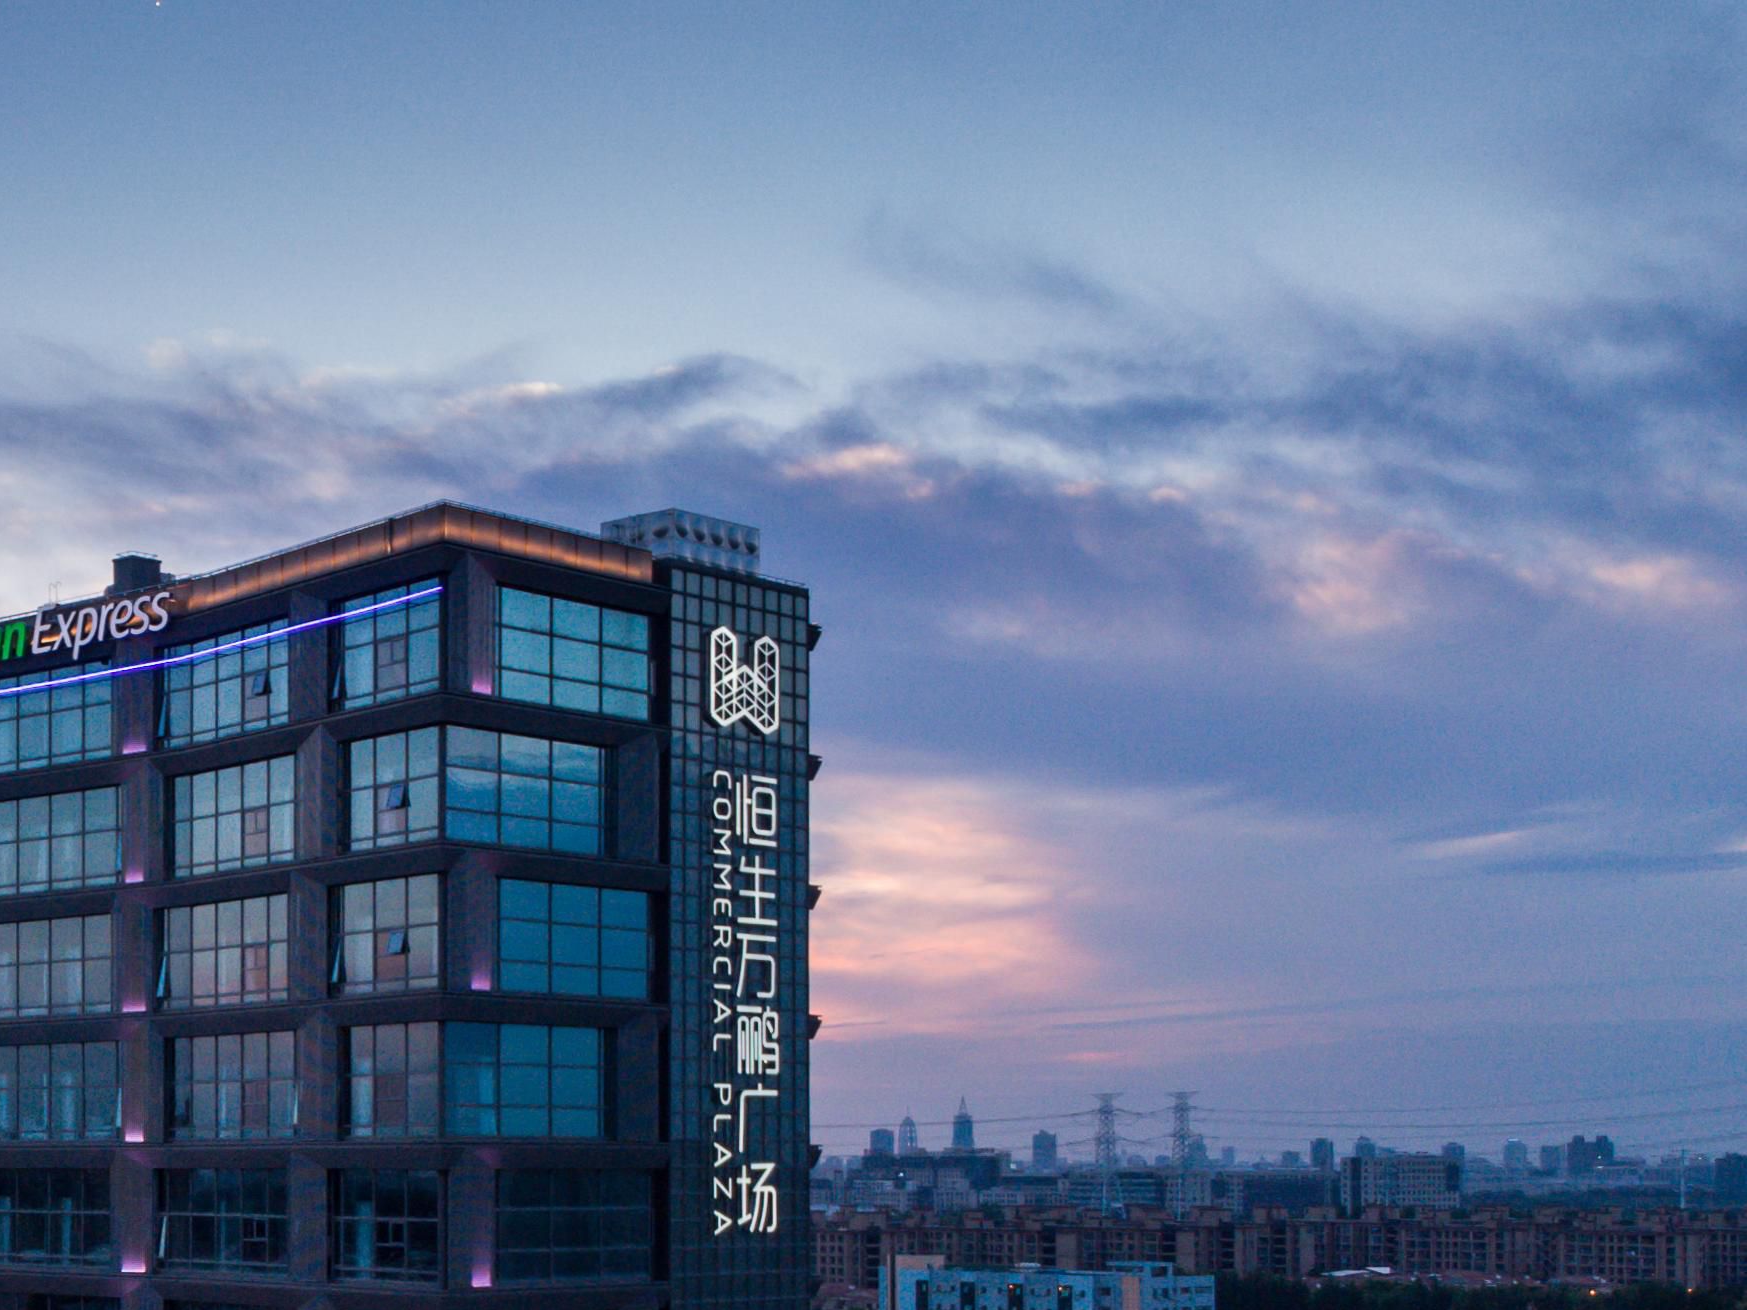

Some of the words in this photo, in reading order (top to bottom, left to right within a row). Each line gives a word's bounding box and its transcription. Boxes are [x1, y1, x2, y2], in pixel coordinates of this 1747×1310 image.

[31, 591, 172, 661] Express
[712, 769, 733, 1052] COMMERCIAL
[712, 1083, 733, 1236] PLAZA
